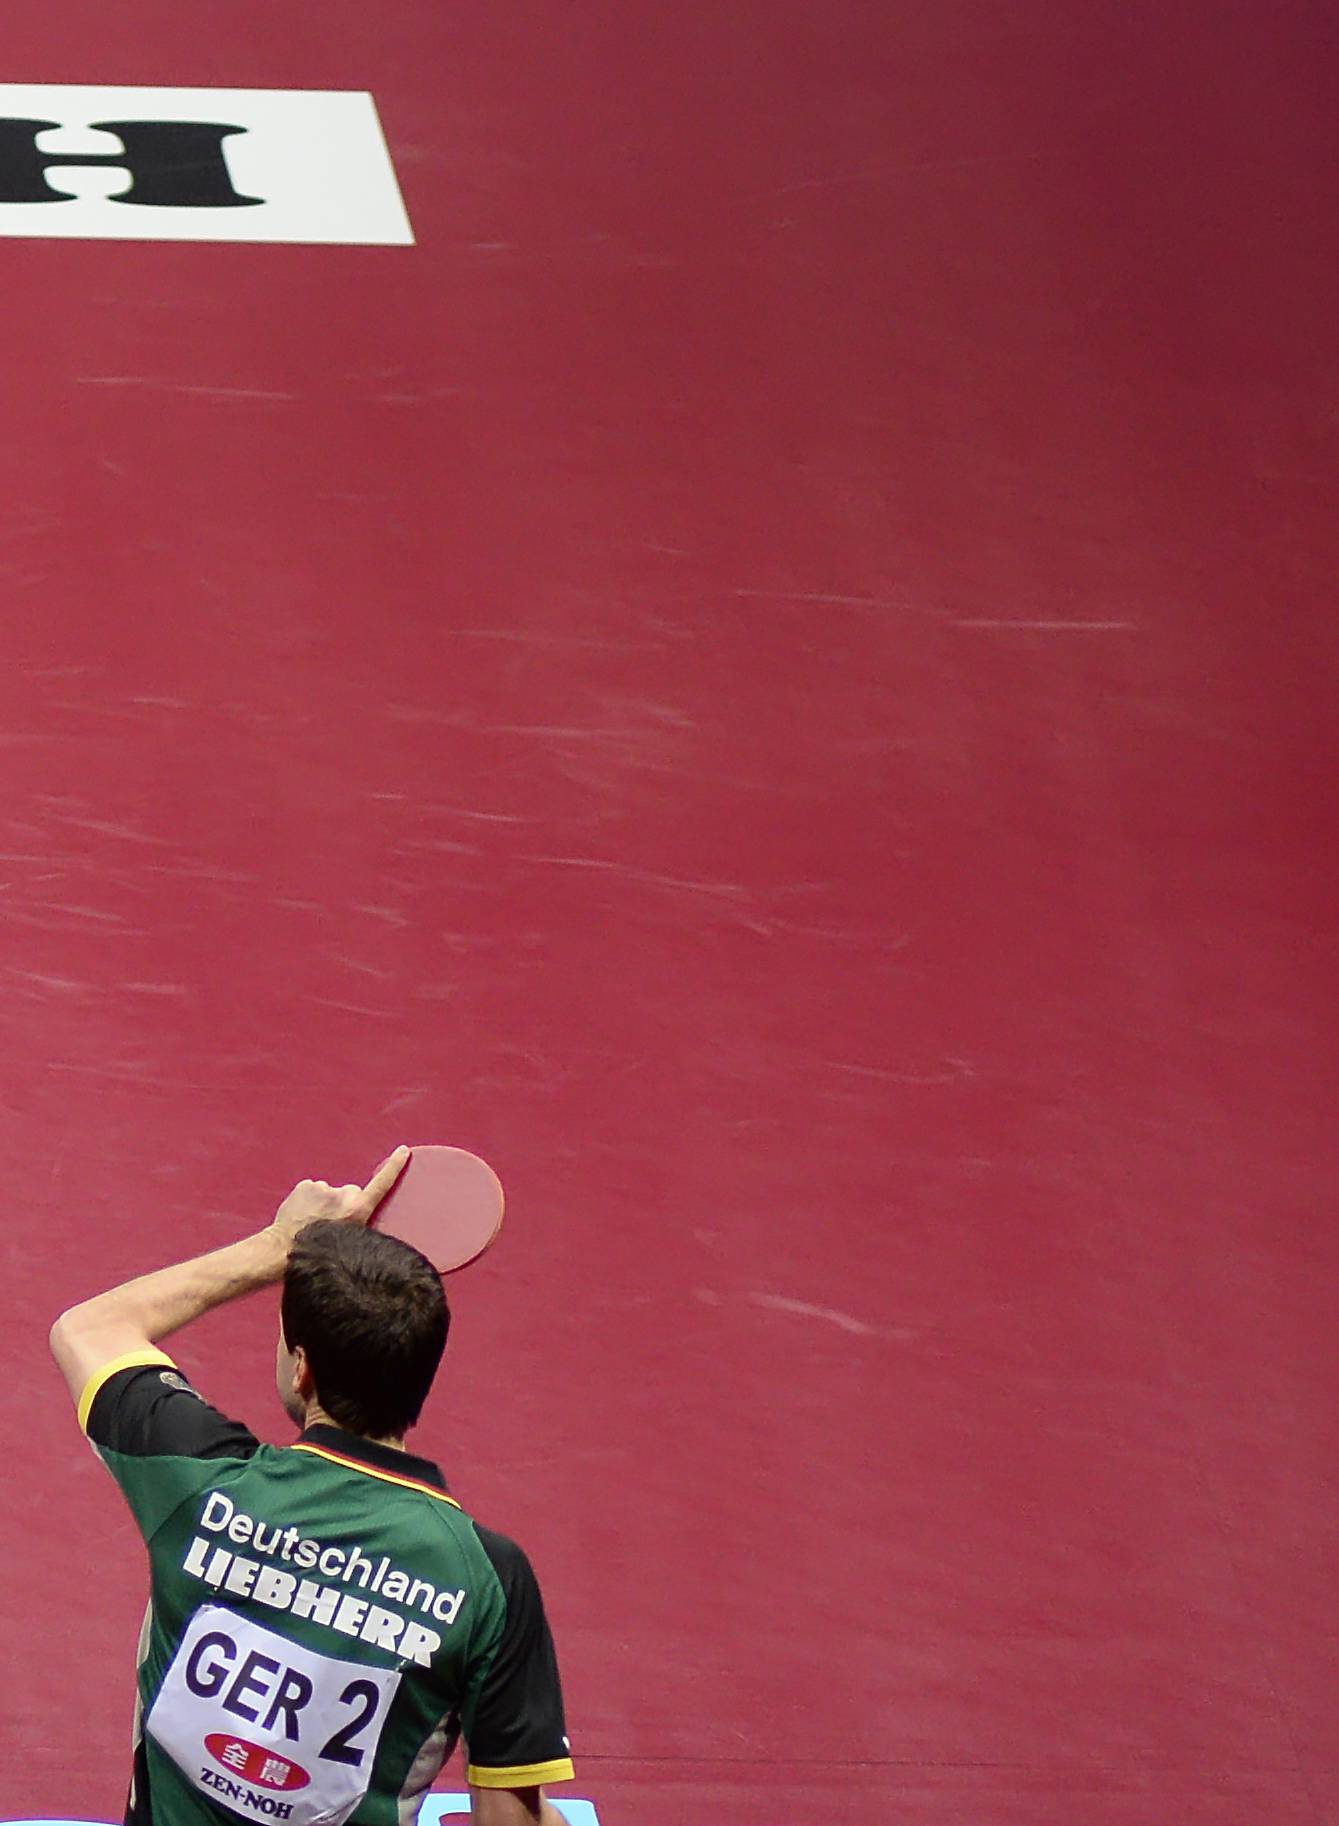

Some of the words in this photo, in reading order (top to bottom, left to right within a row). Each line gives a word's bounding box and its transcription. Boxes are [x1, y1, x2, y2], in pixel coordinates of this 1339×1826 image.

[182, 1536, 442, 1669] LIEBHERR
[199, 1491, 466, 1626] Deutschland
[185, 1630, 315, 1742] GER
[318, 1678, 381, 1768] 2
[200, 1766, 295, 1820] ZEN-NOH
